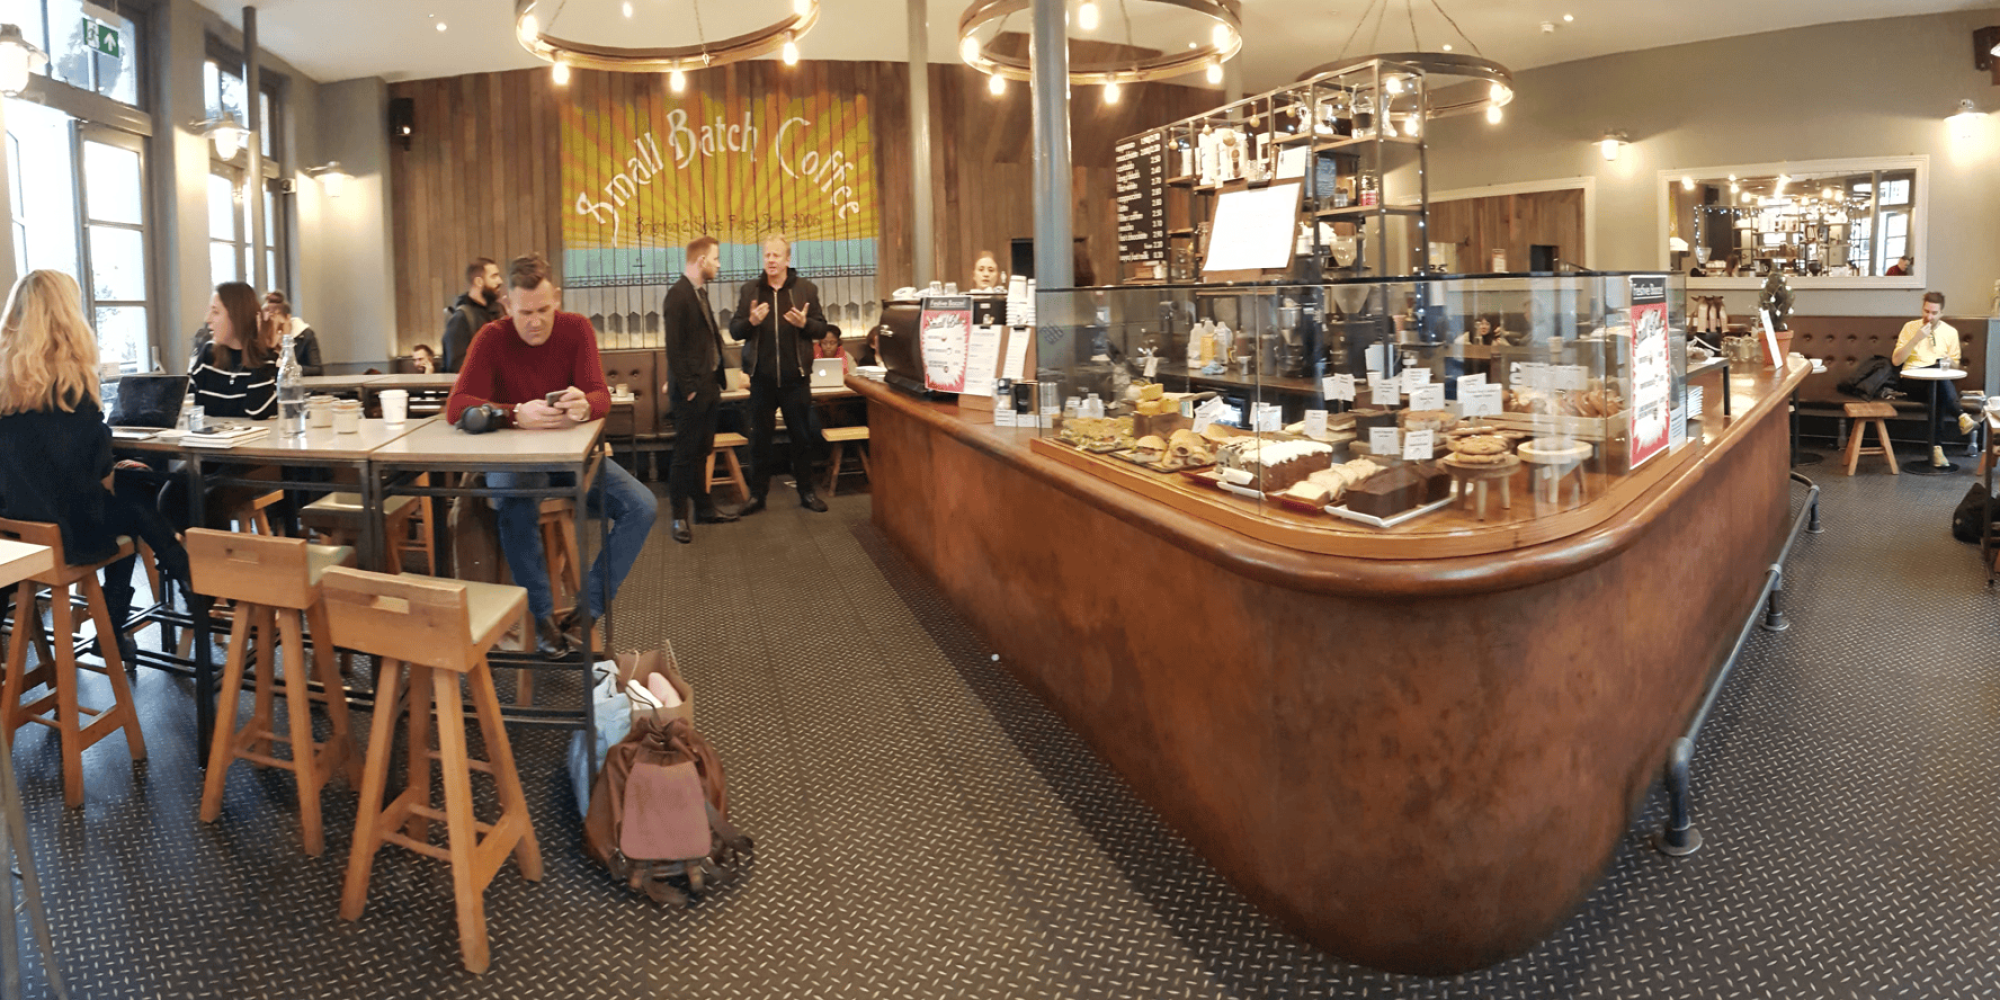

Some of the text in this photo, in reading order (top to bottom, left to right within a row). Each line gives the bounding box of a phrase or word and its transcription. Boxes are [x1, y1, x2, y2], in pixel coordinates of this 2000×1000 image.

[576, 108, 860, 247] Small Batch Coffee
